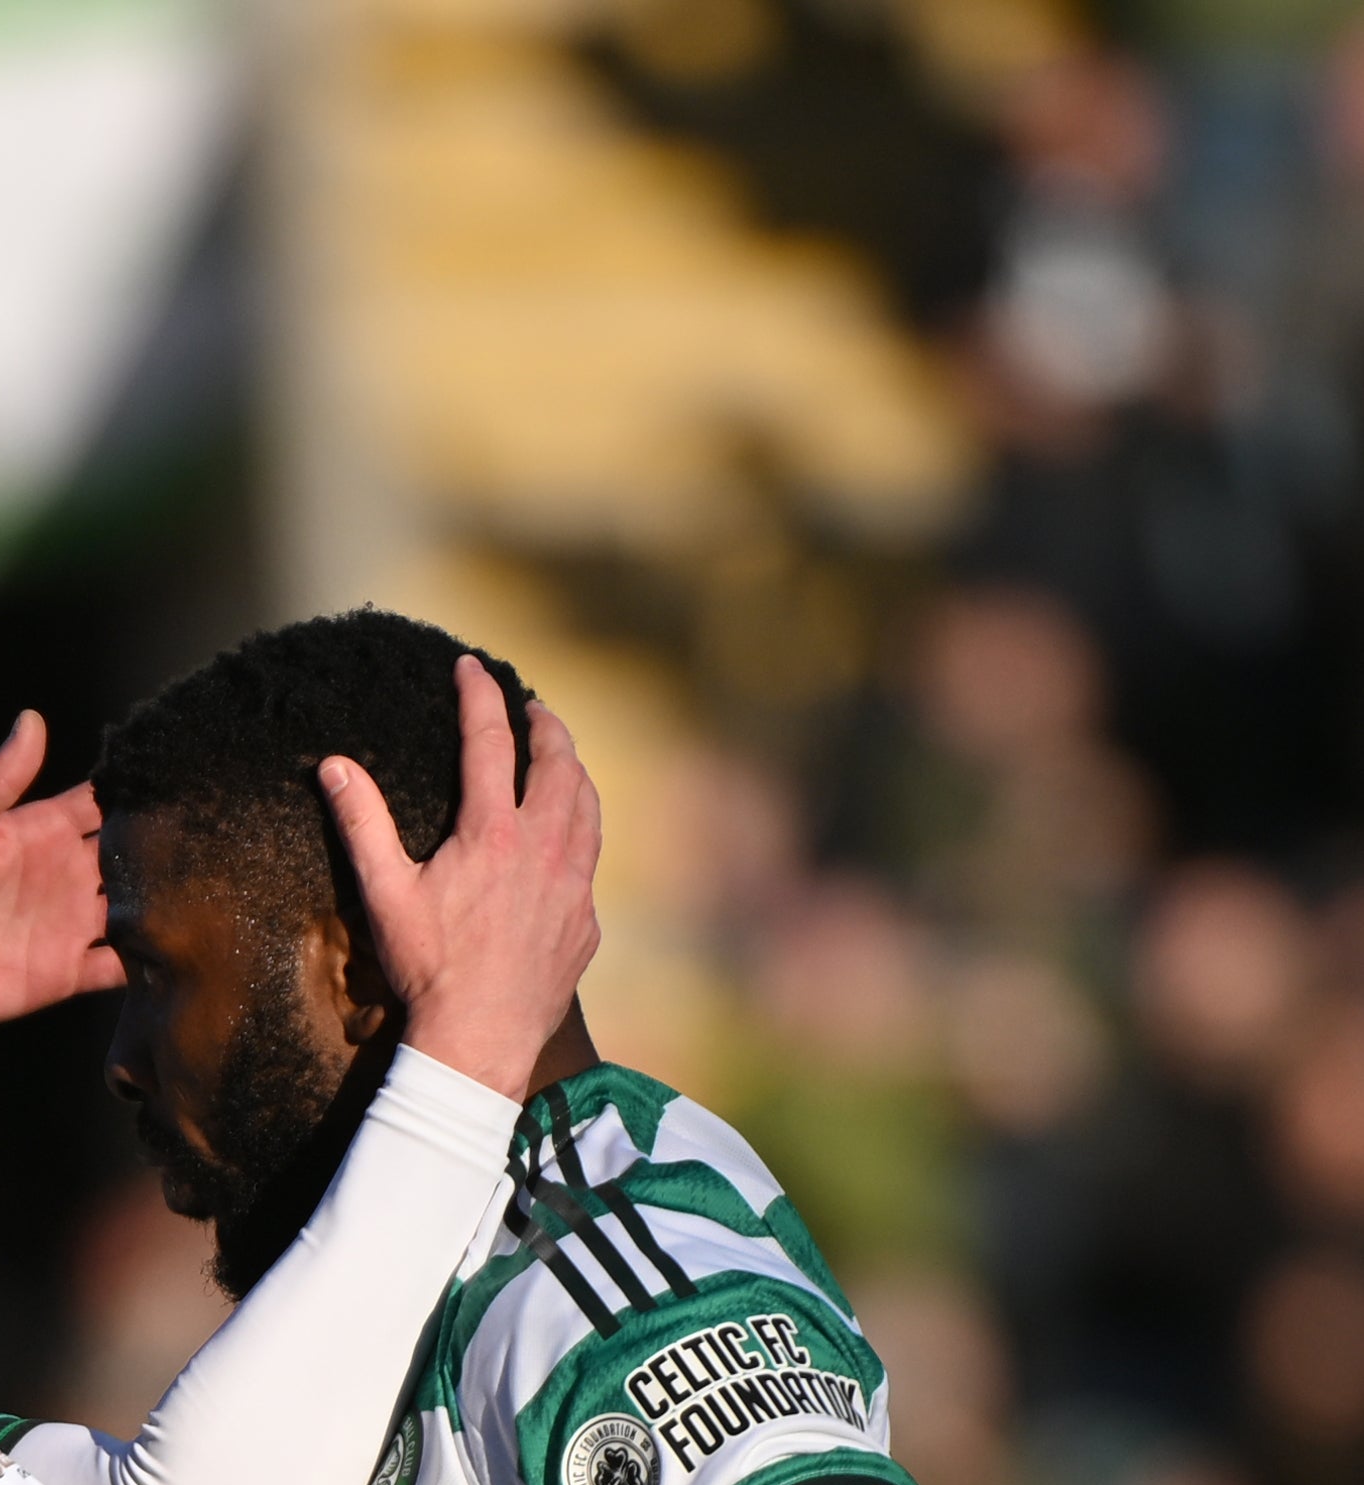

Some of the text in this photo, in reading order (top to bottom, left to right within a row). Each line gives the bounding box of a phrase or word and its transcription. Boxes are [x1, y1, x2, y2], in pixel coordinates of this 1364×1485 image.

[629, 1317, 807, 1421] CELTIC FC
[579, 1422, 638, 1453] FOUNDATION
[658, 1371, 866, 1473] FOUNDATION
[573, 1453, 588, 1467] FC
